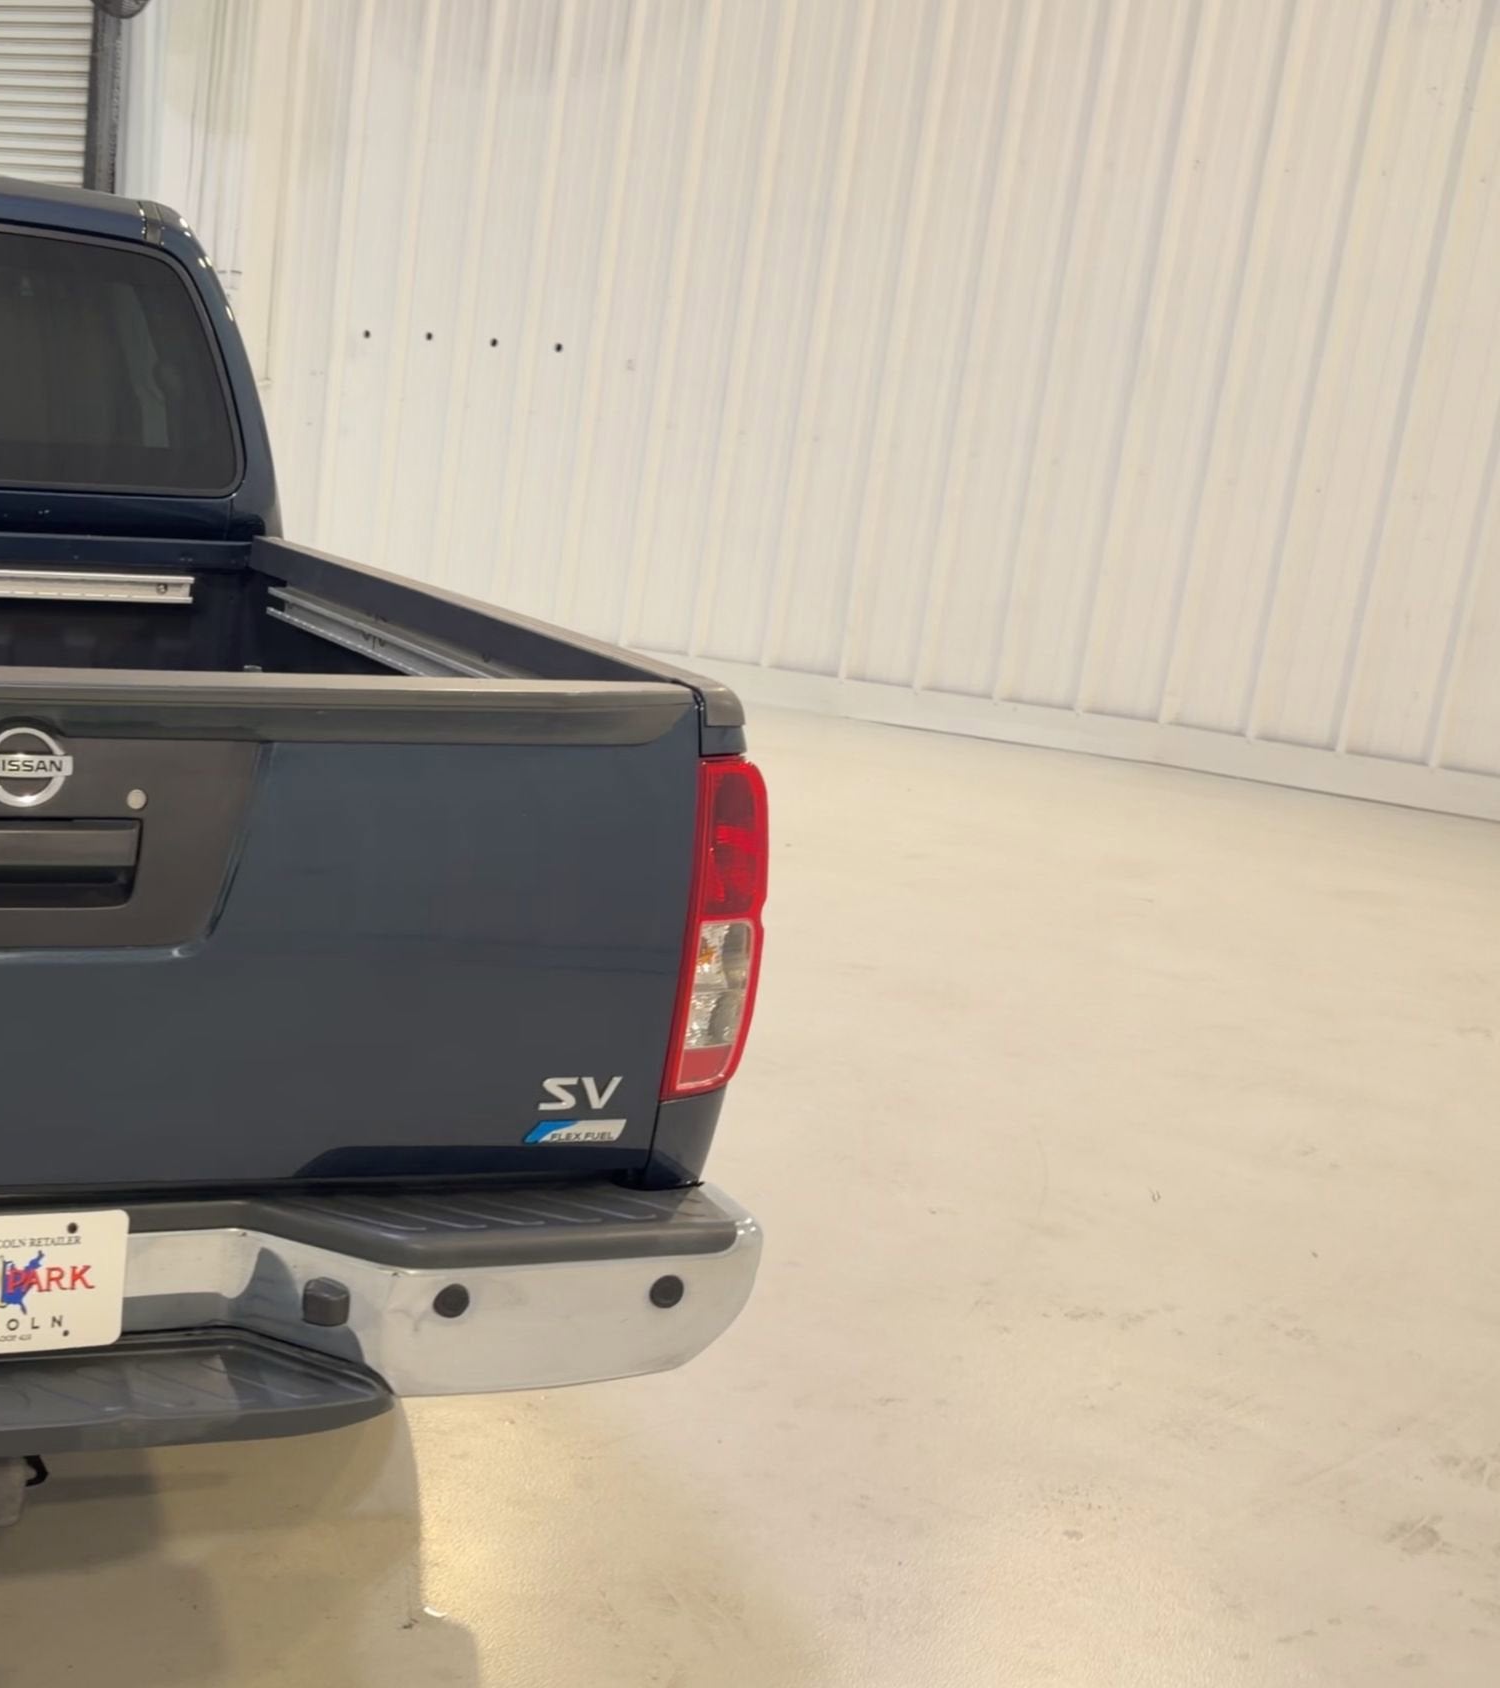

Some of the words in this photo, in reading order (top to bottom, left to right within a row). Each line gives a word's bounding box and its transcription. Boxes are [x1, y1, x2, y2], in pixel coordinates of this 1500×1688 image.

[538, 1076, 623, 1111] SV
[550, 1132, 581, 1141] FLEX
[584, 1131, 614, 1141] FUEL
[28, 1235, 82, 1248] RETAILER
[6, 1265, 96, 1295] PARK
